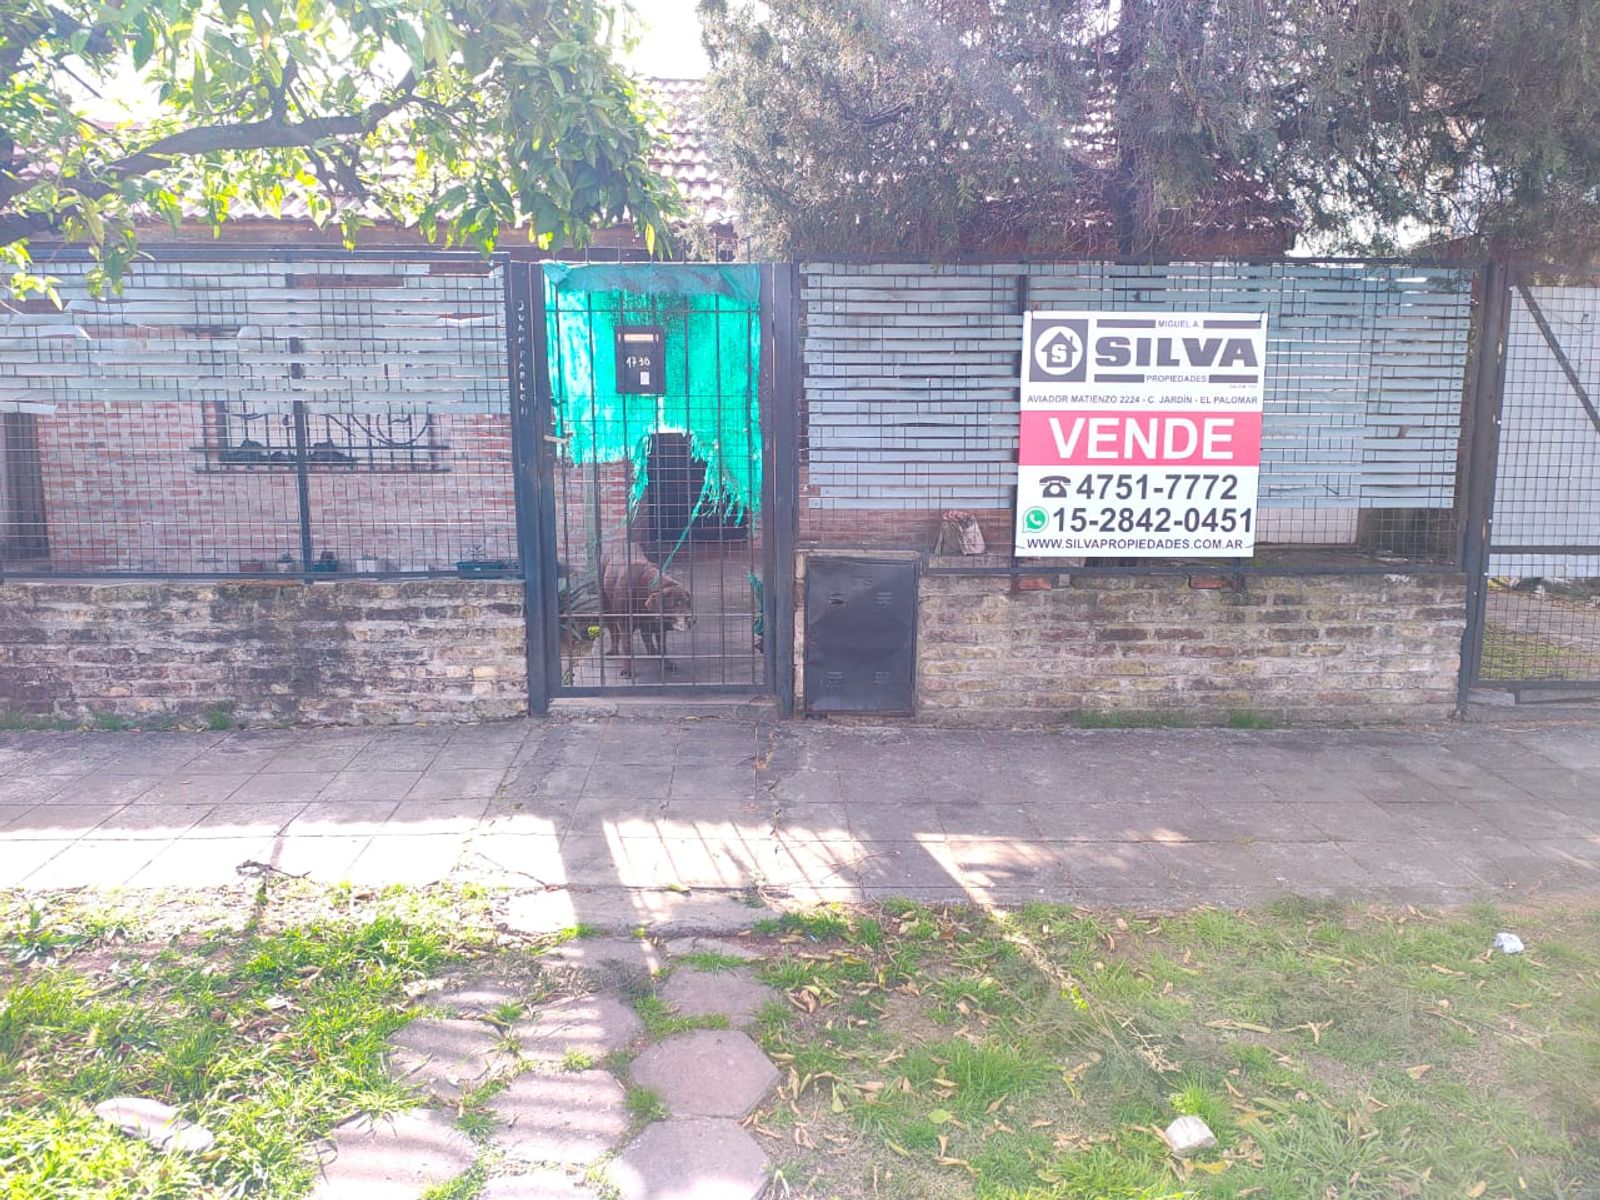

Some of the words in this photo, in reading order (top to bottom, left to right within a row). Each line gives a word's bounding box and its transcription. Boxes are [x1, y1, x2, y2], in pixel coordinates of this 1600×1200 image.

[1157, 319, 1189, 329] MIGUEL
[1095, 336, 1259, 368] SILVA
[1145, 374, 1208, 383] PROPIEDADES
[1026, 394, 1069, 404] AVIADOR
[1070, 394, 1118, 404] MATIENZO
[1119, 395, 1141, 404] 2224
[1158, 394, 1193, 404] JARDÍN
[1199, 396, 1212, 404] EL
[1213, 395, 1258, 405] PALOMAR
[1048, 417, 1235, 460] VENDE
[1076, 473, 1238, 500] 4751-7772
[1053, 507, 1252, 533] 15-2842-0451
[1026, 538, 1243, 550] WWW.SILVAPROPIEDADES.COM.AR
